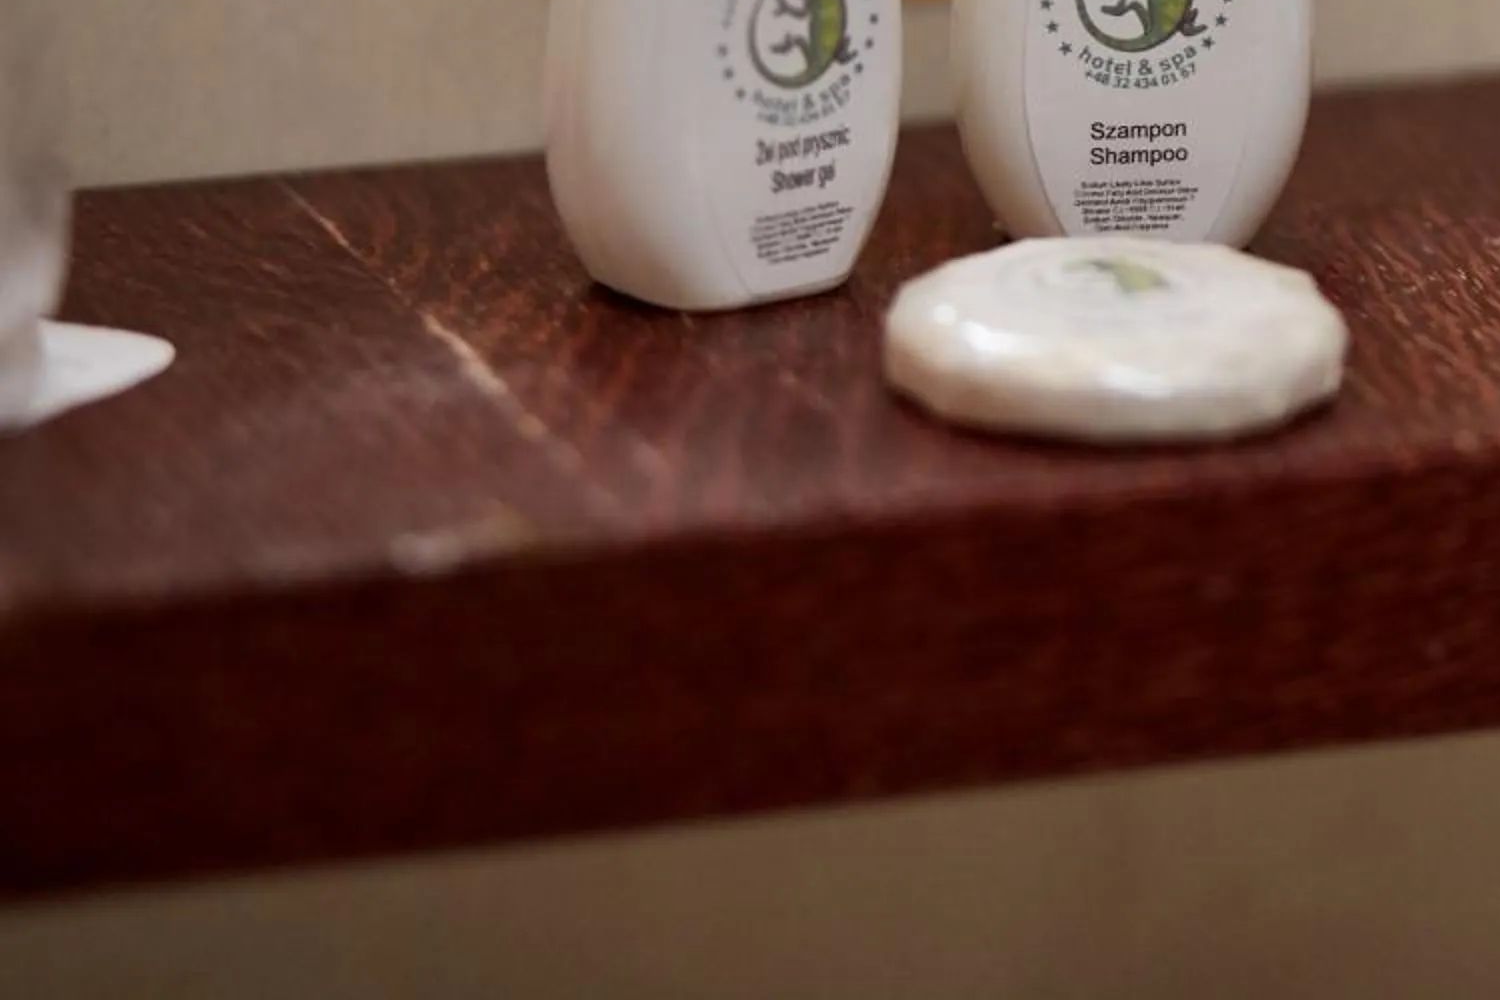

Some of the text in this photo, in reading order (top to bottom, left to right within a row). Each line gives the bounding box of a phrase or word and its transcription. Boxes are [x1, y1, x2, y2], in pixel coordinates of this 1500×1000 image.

[1077, 44, 1198, 76] hotel & spa
[1090, 121, 1188, 142] Szampon
[1090, 147, 1189, 166] Shampoo
